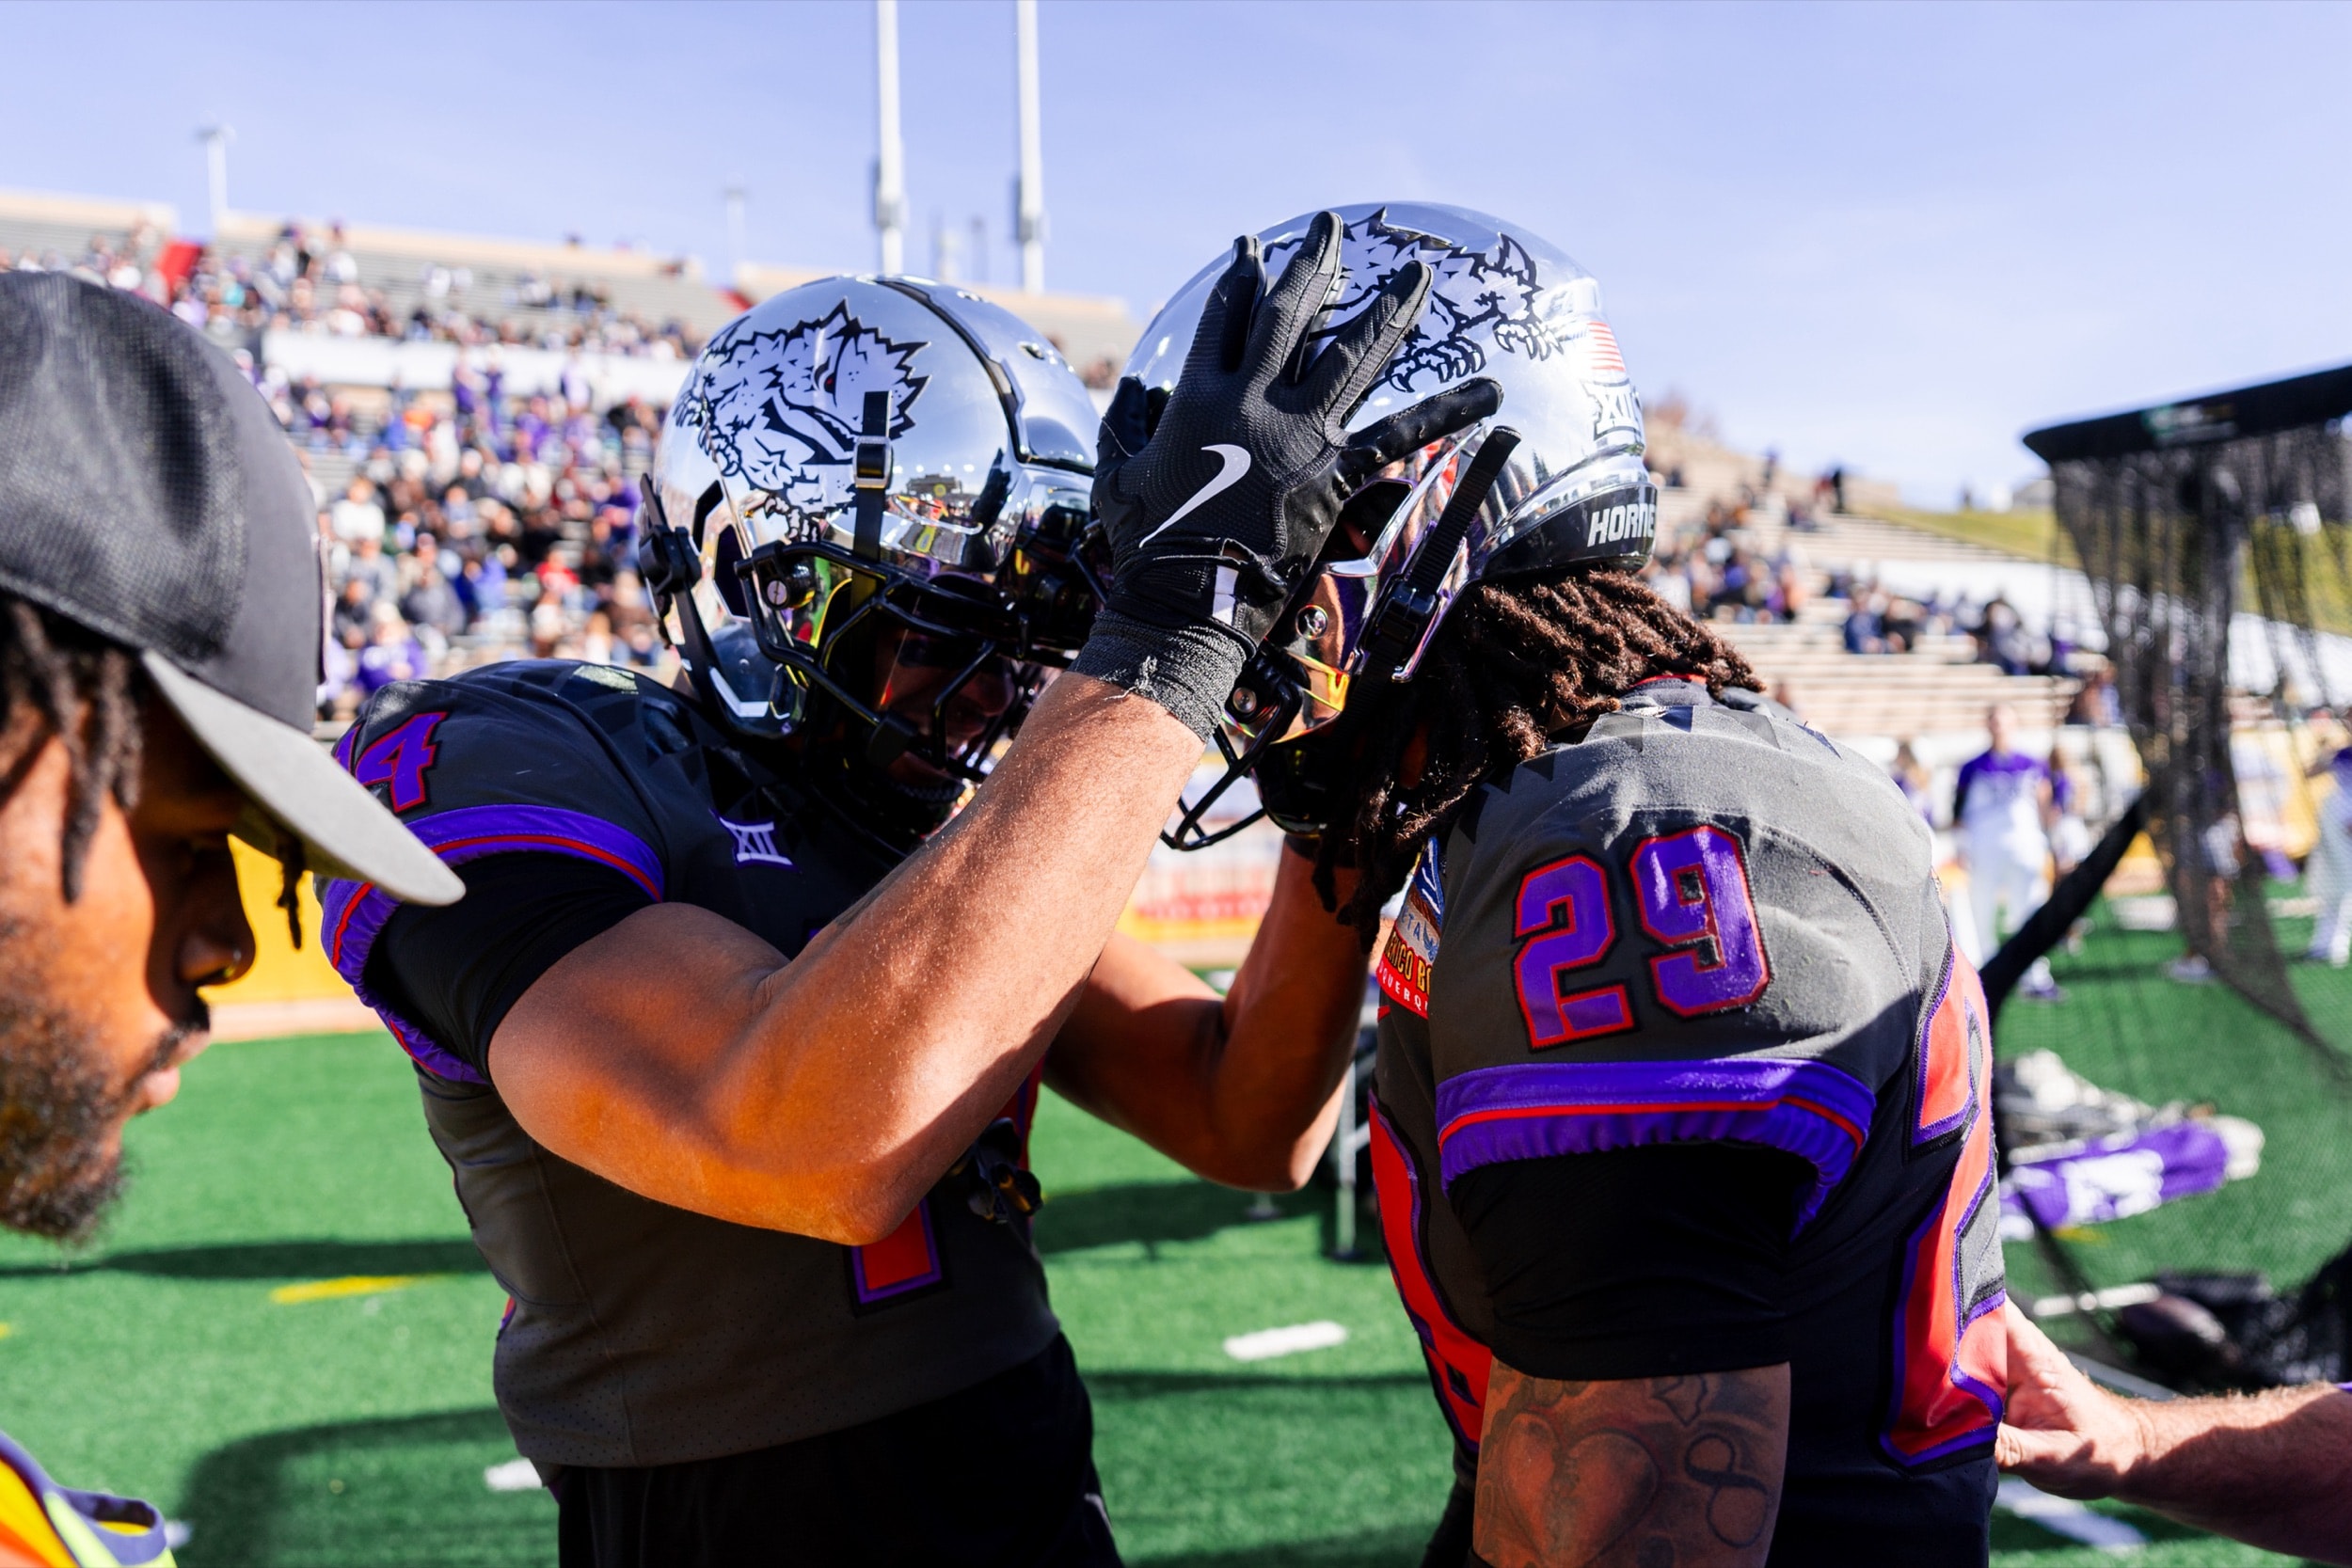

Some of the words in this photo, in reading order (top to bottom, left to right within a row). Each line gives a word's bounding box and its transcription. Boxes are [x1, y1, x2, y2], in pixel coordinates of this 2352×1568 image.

[719, 816, 793, 866] XII
[1385, 930, 1414, 981] EXICO
[1514, 824, 1771, 1049] 29
